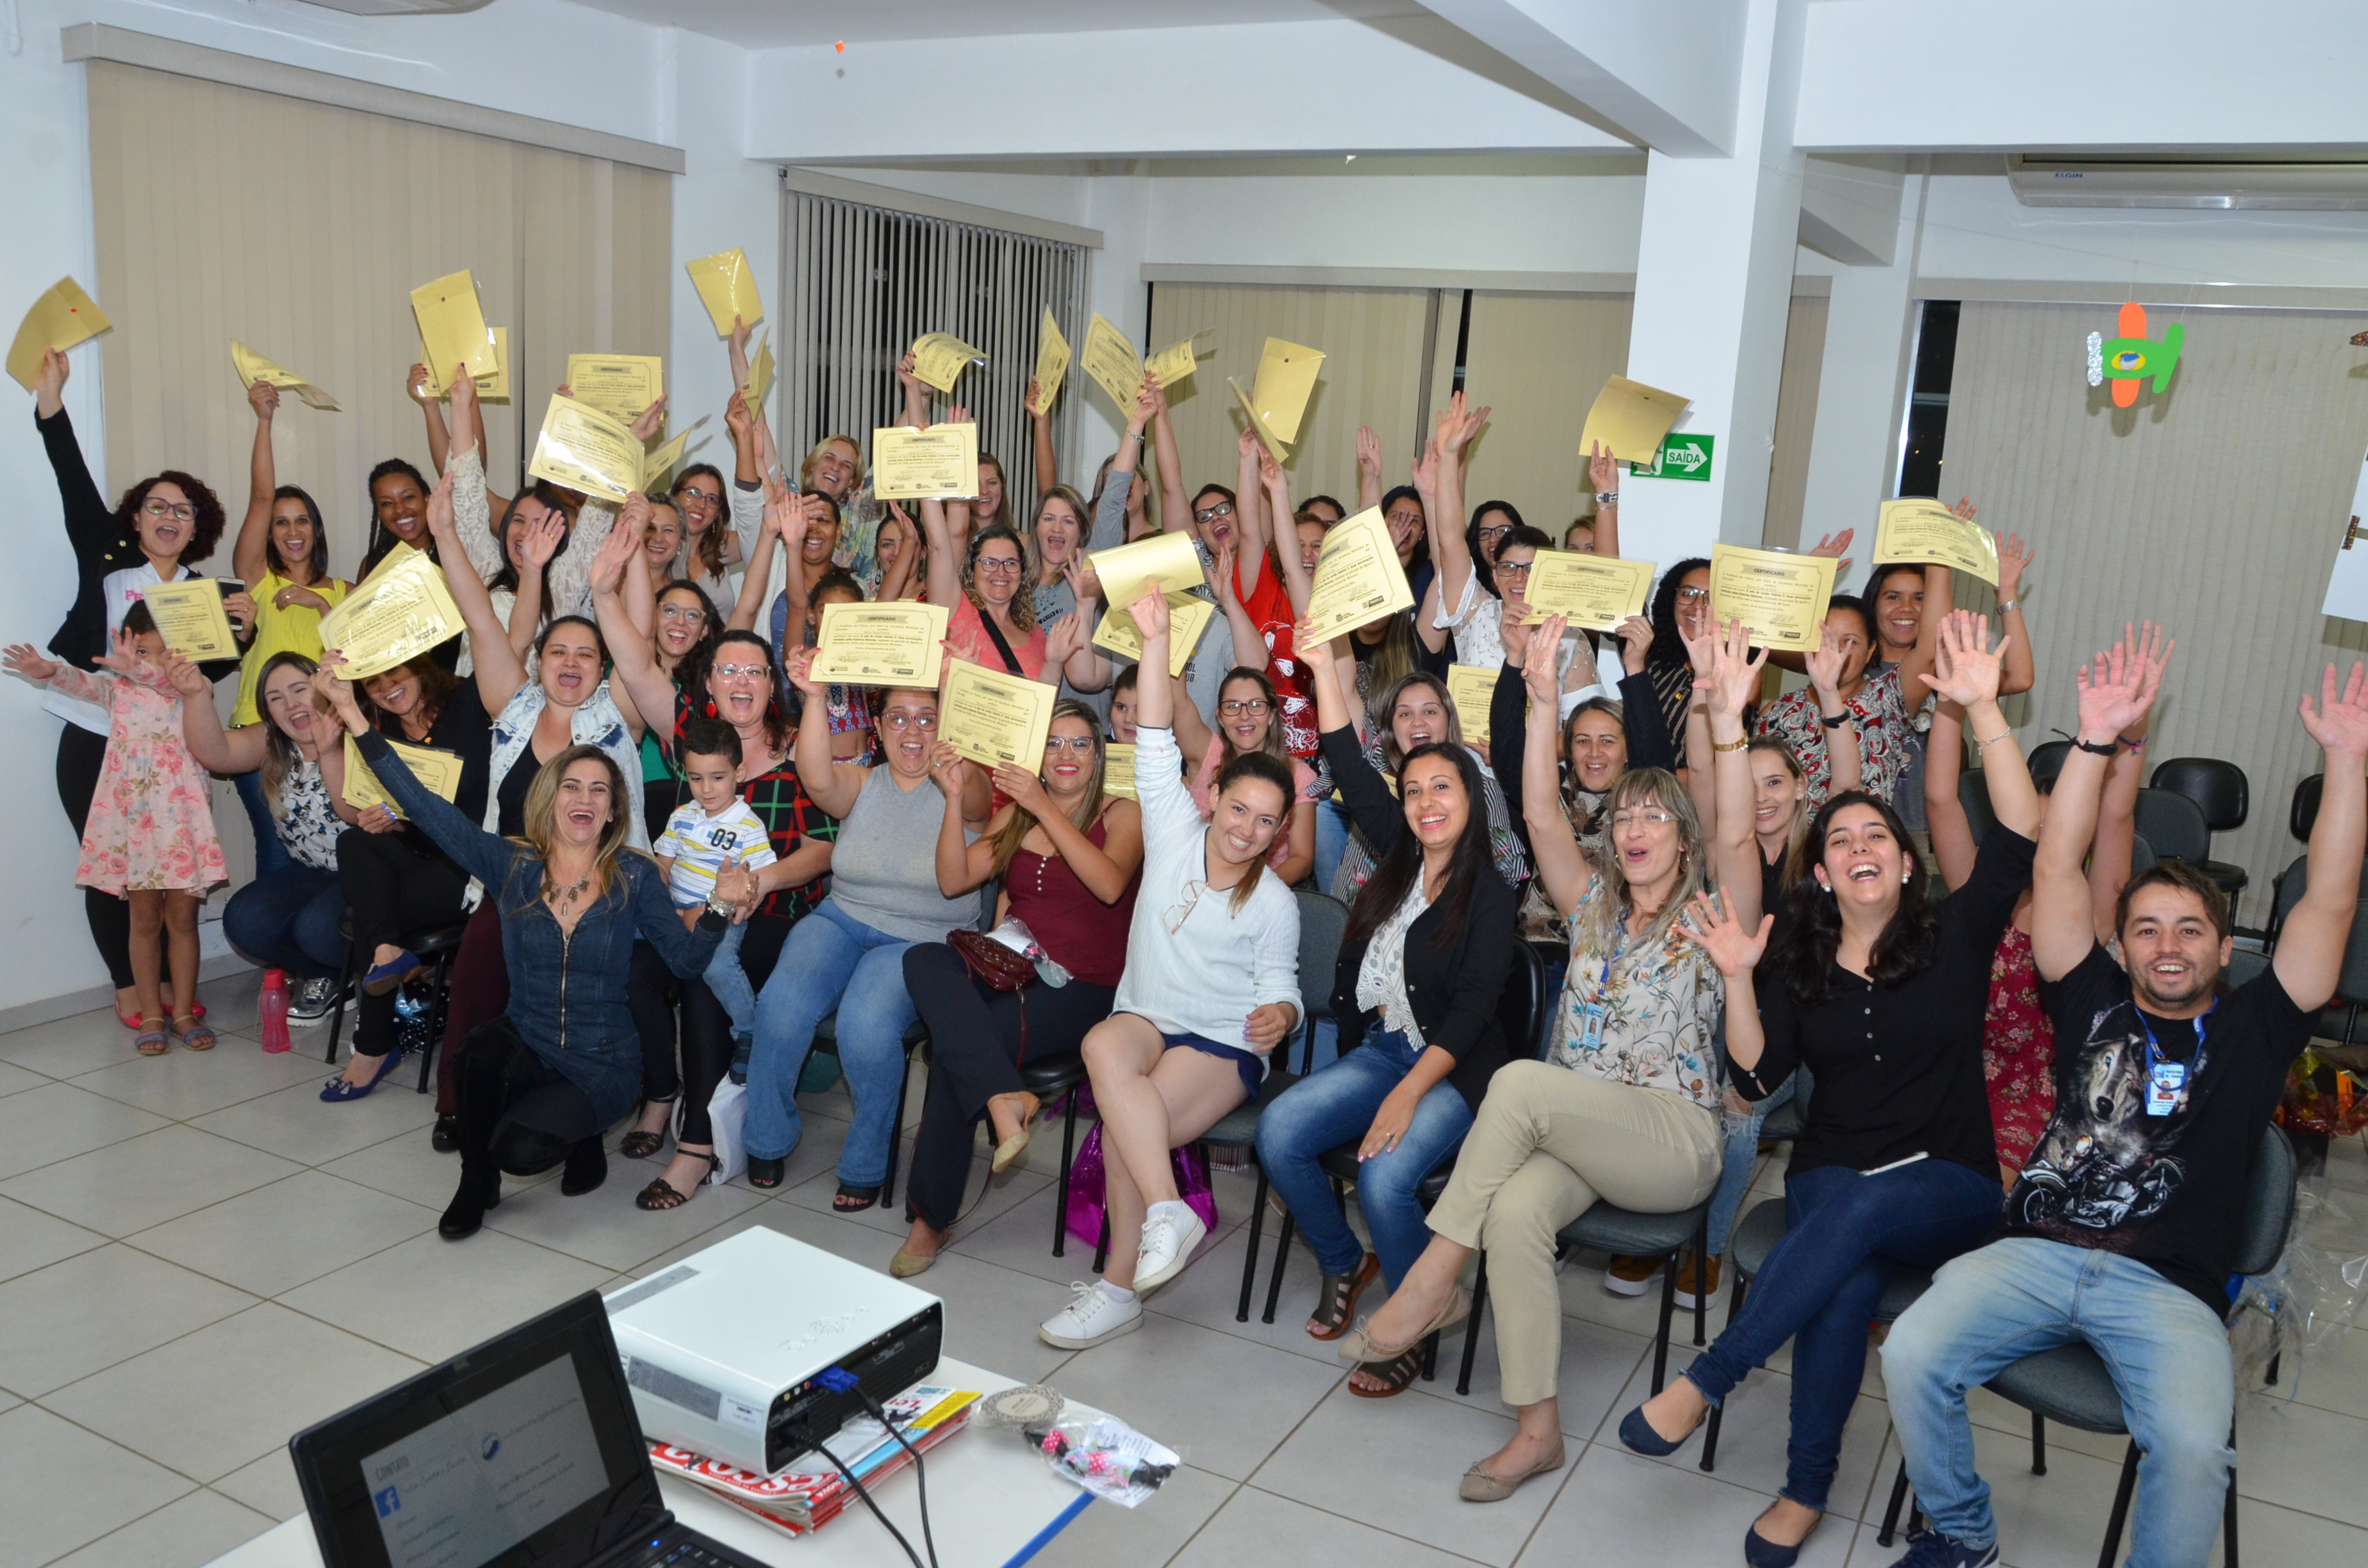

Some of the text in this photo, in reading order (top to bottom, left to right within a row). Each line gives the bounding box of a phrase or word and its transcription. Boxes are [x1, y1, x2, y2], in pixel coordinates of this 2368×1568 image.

[1668, 450, 1701, 464] SAÍDA
[1754, 568, 1785, 576] CERTIFICADO
[981, 685, 1005, 696] CERTIFICADO
[711, 828, 737, 851] 03
[818, 1480, 843, 1498] NOVA
